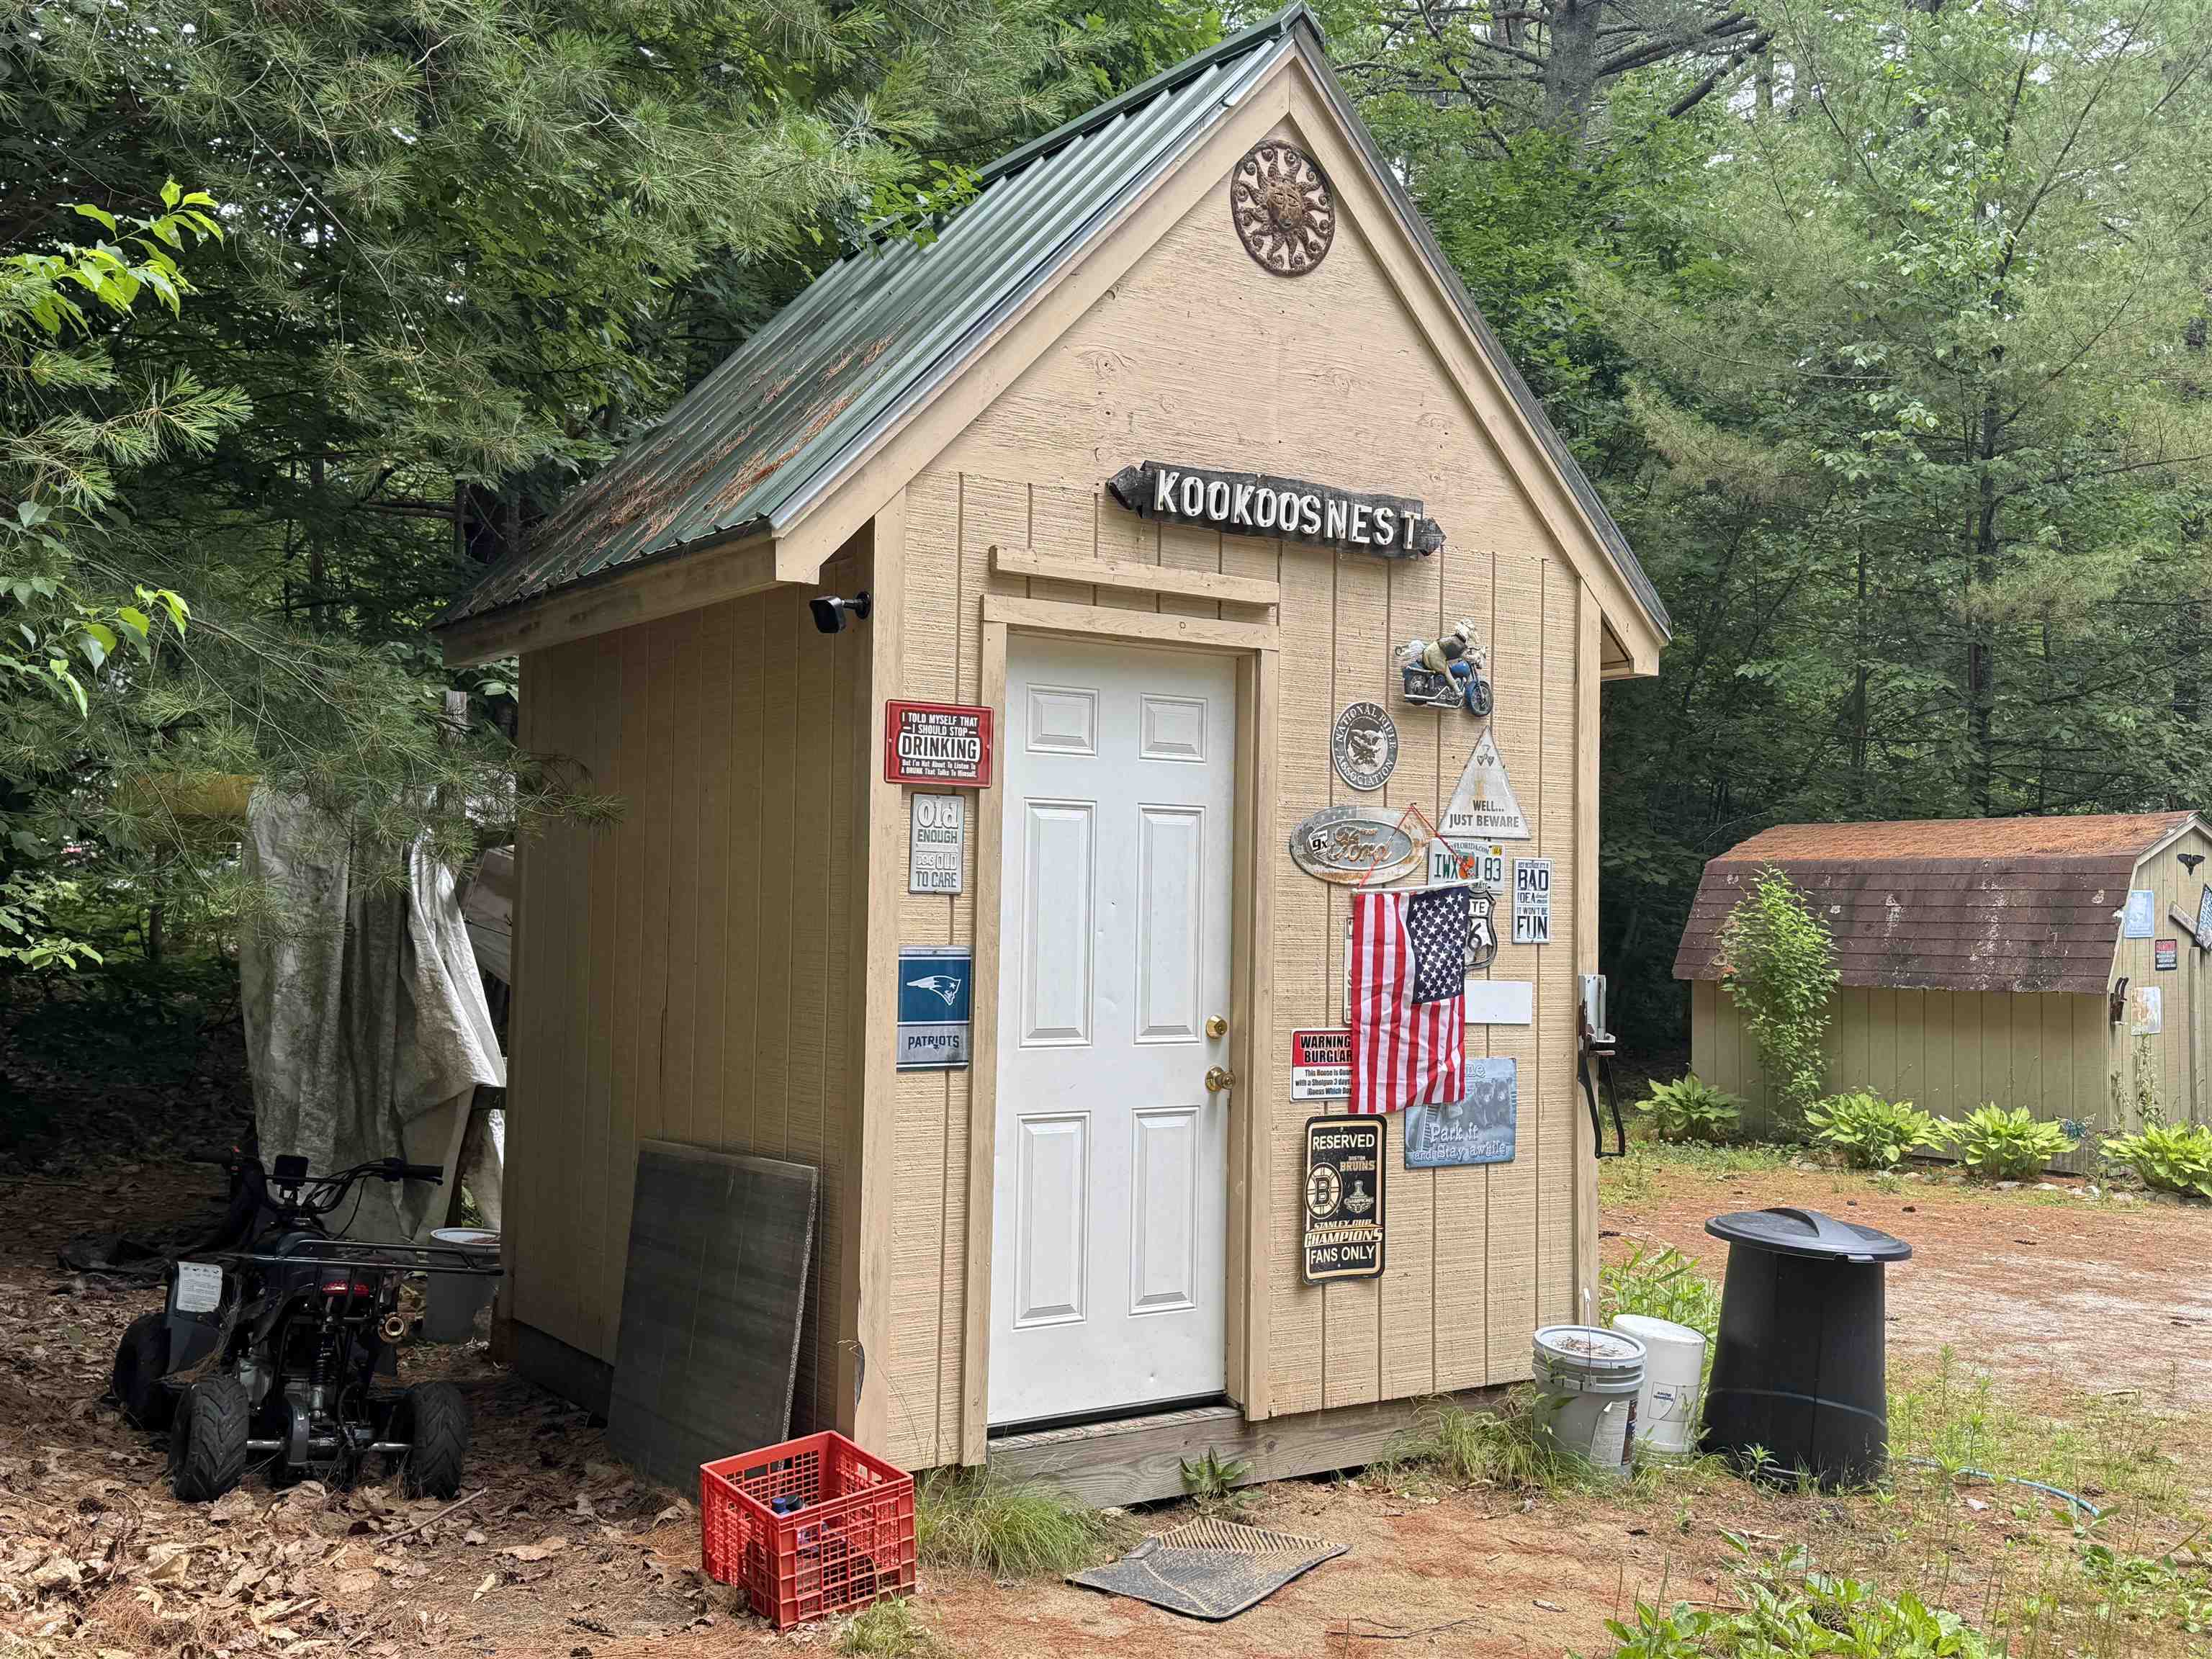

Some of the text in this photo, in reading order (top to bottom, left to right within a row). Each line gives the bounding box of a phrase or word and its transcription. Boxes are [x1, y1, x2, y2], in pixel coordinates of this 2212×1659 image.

[902, 712, 979, 727] I TOLD MYSELF THAT
[1336, 705, 1397, 750] NATIONAL RIFLE
[912, 724, 968, 737] I SHOULD STOP
[902, 735, 977, 760] DRINKING
[1336, 755, 1394, 786] ASSOCIATION
[1473, 800, 1504, 812] WELL...
[1449, 814, 1519, 828] JUST BEWARE
[917, 828, 958, 844] ENOUGH
[935, 853, 958, 871] OLD
[916, 871, 957, 888] TO CARE
[1517, 868, 1549, 891] BAD
[1517, 892, 1535, 904] IDEA
[1517, 907, 1548, 916] IT WON'T BE
[1516, 915, 1548, 940] FUN
[908, 1035, 960, 1051] PATRIOTS
[1300, 1035, 1352, 1049] WARNING
[1305, 1069, 1316, 1077] This
[1312, 1079, 1334, 1087] Shotgun
[1325, 1087, 1342, 1095] Which
[1430, 1118, 1479, 1143] Park it
[1312, 1133, 1375, 1151] RESERVED
[1413, 1140, 1508, 1162] and Stay awhile
[1339, 1160, 1376, 1172] BRUINS
[1314, 1175, 1331, 1206] B
[1314, 1218, 1372, 1229] STANLEY CUP
[1304, 1227, 1383, 1248] CHAMPIONS
[1310, 1245, 1376, 1265] FANS ONLY
